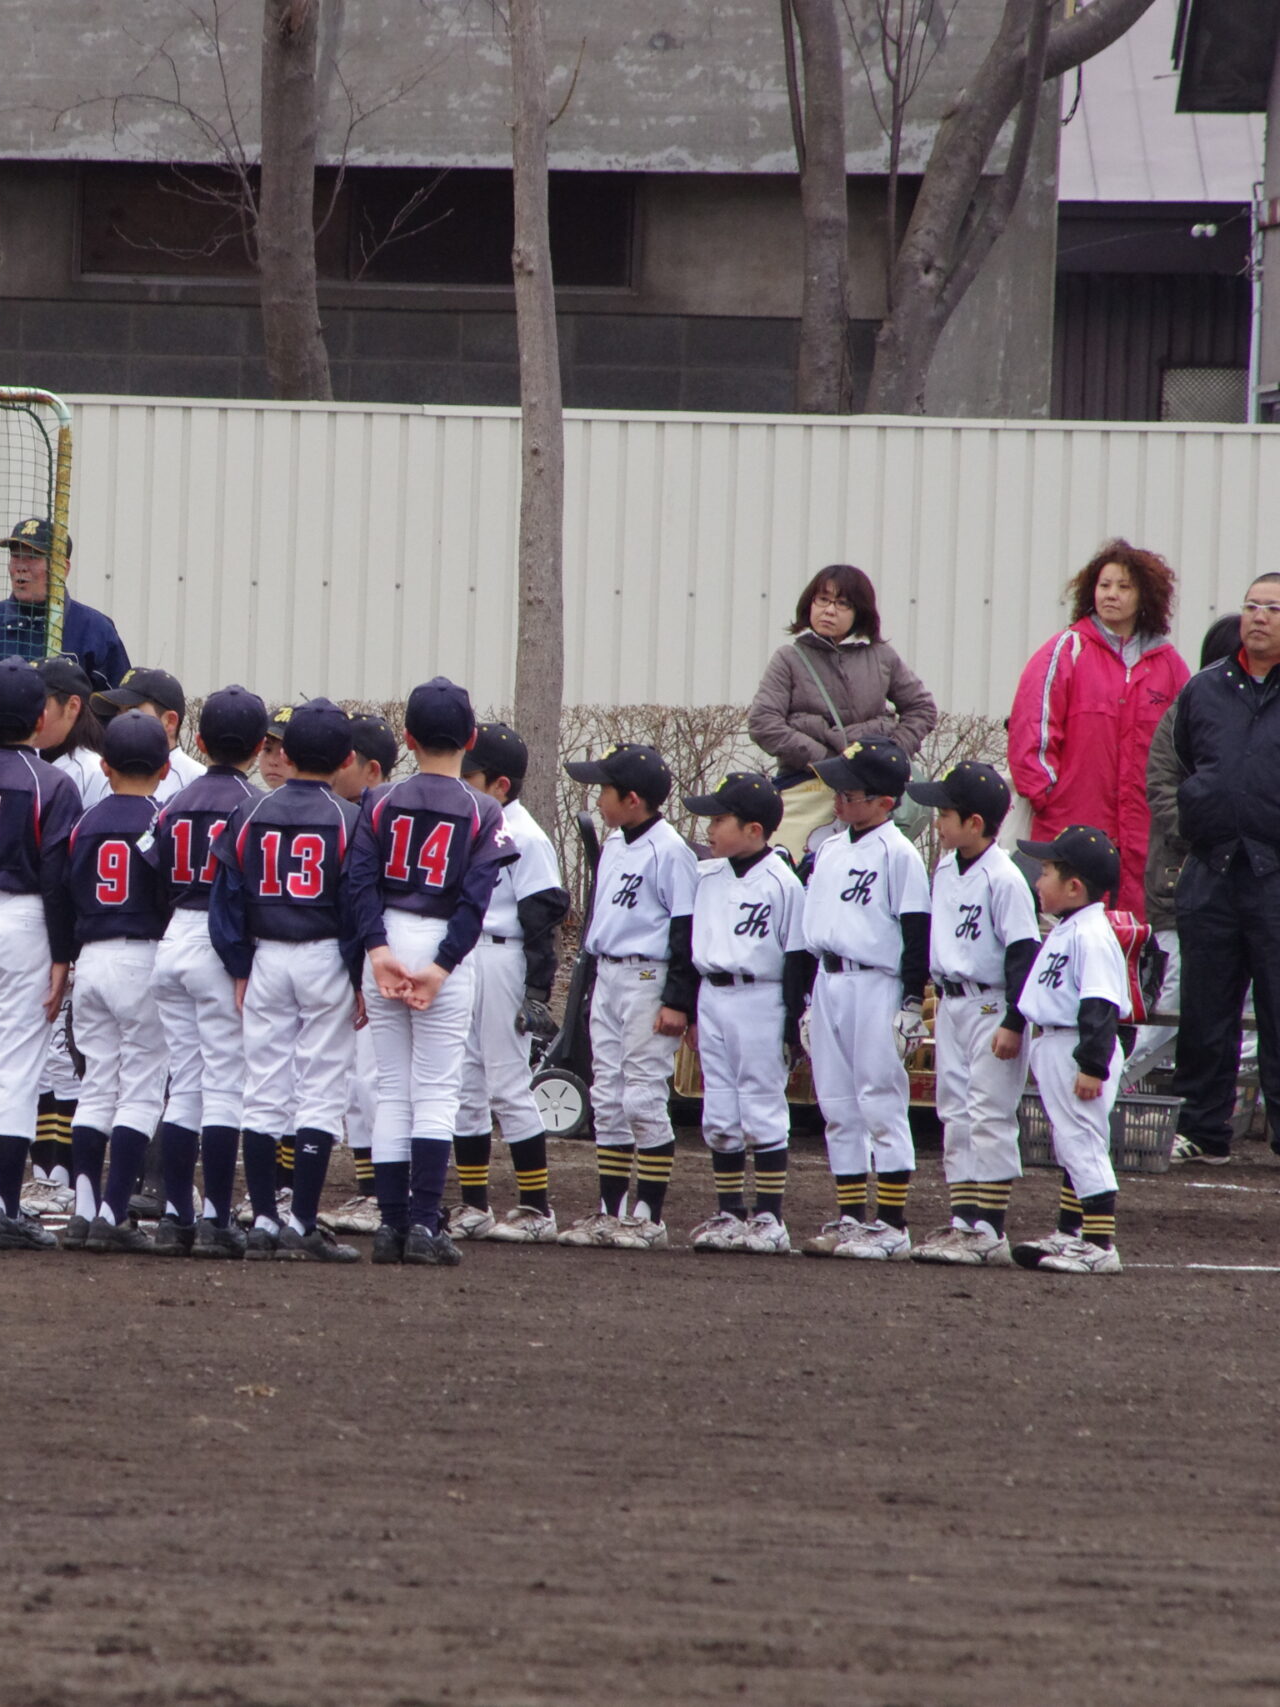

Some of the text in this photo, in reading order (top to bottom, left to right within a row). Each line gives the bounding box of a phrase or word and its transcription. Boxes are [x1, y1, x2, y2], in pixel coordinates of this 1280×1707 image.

[96, 840, 131, 905] 9
[259, 830, 325, 899] 13
[384, 814, 456, 888] 14
